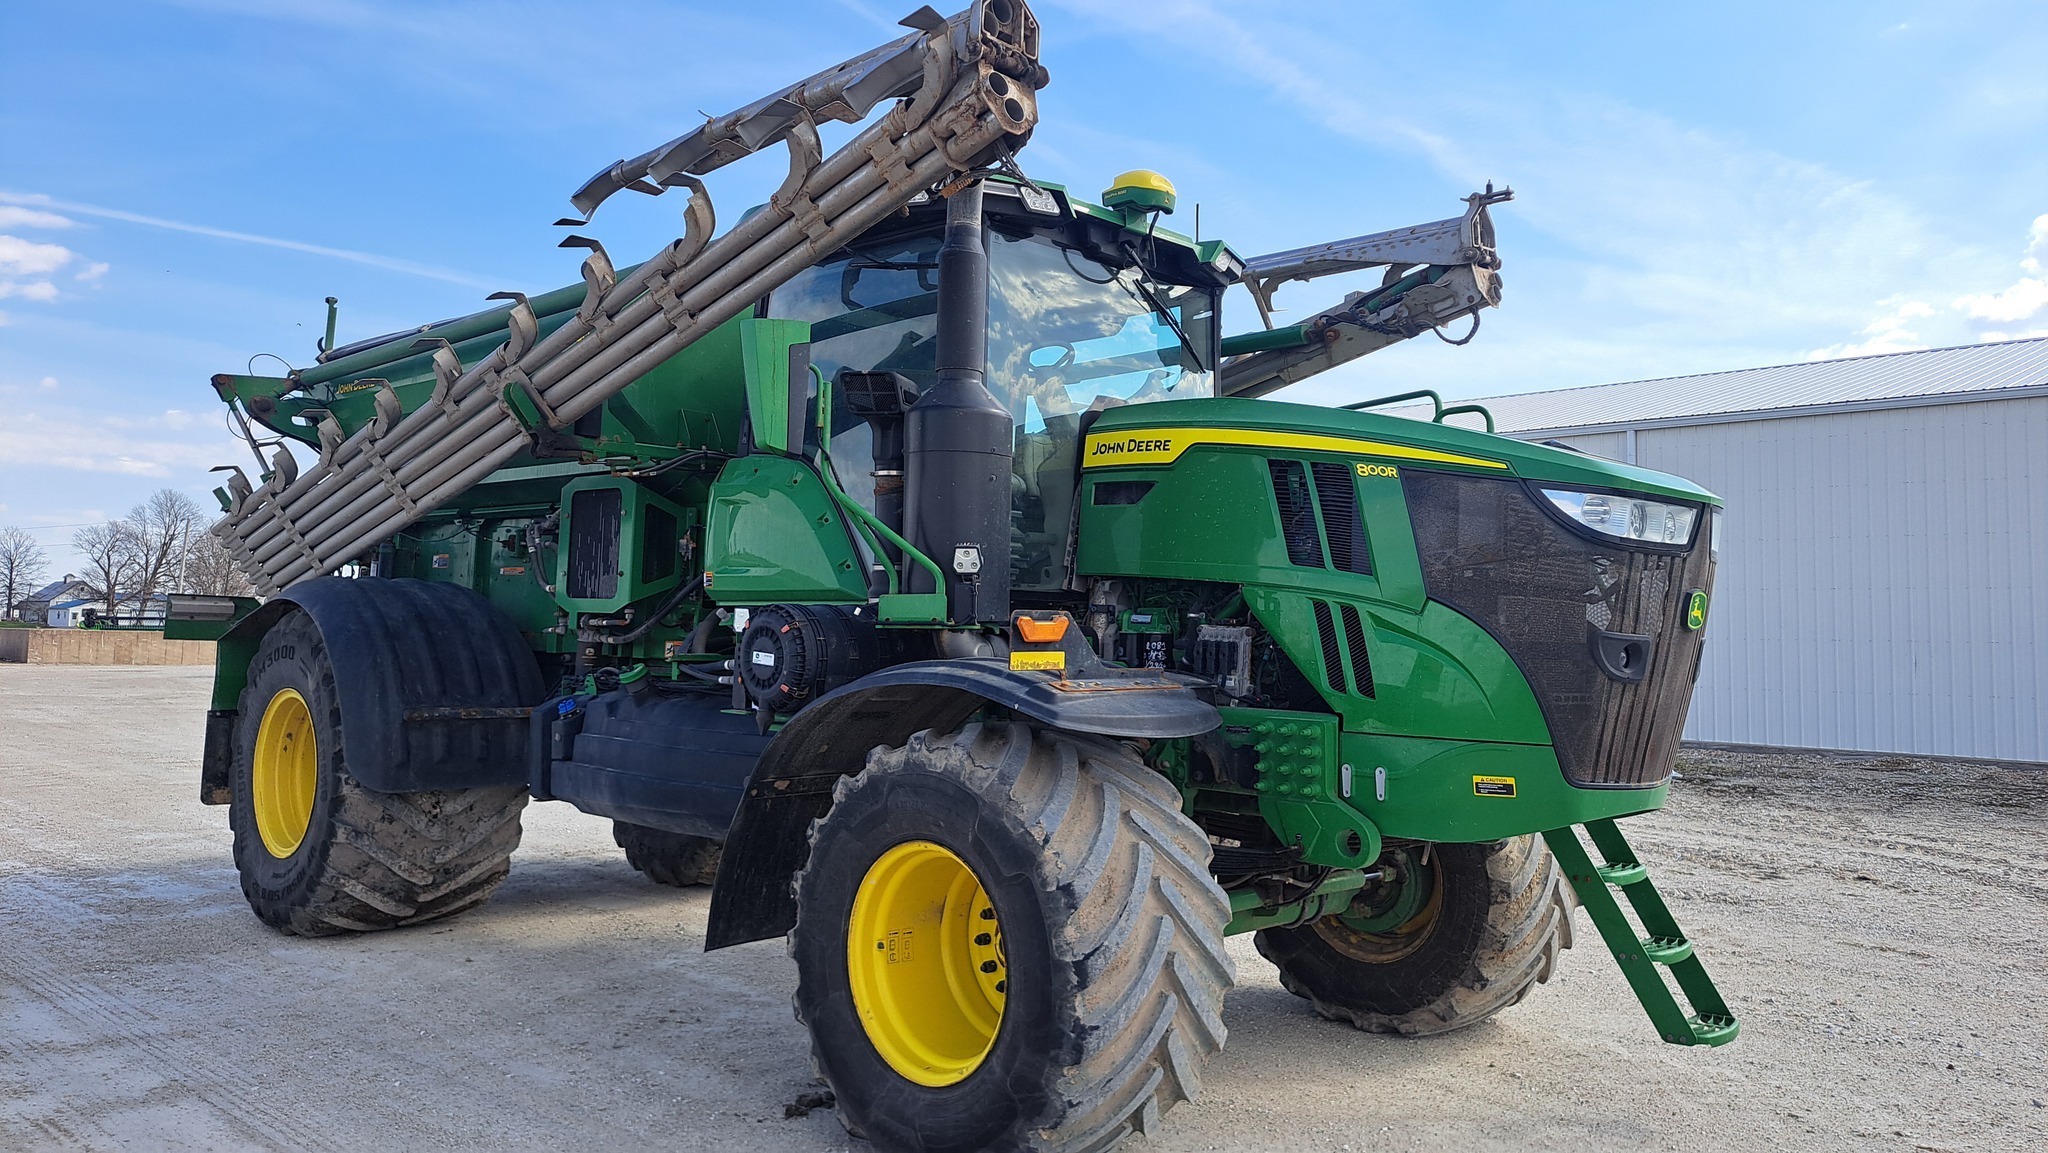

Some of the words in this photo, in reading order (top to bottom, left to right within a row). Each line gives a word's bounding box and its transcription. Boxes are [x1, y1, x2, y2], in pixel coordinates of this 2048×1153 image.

[1092, 442, 1125, 456] JOHN
[1127, 439, 1172, 452] DEERE
[1356, 463, 1398, 478] 800R
